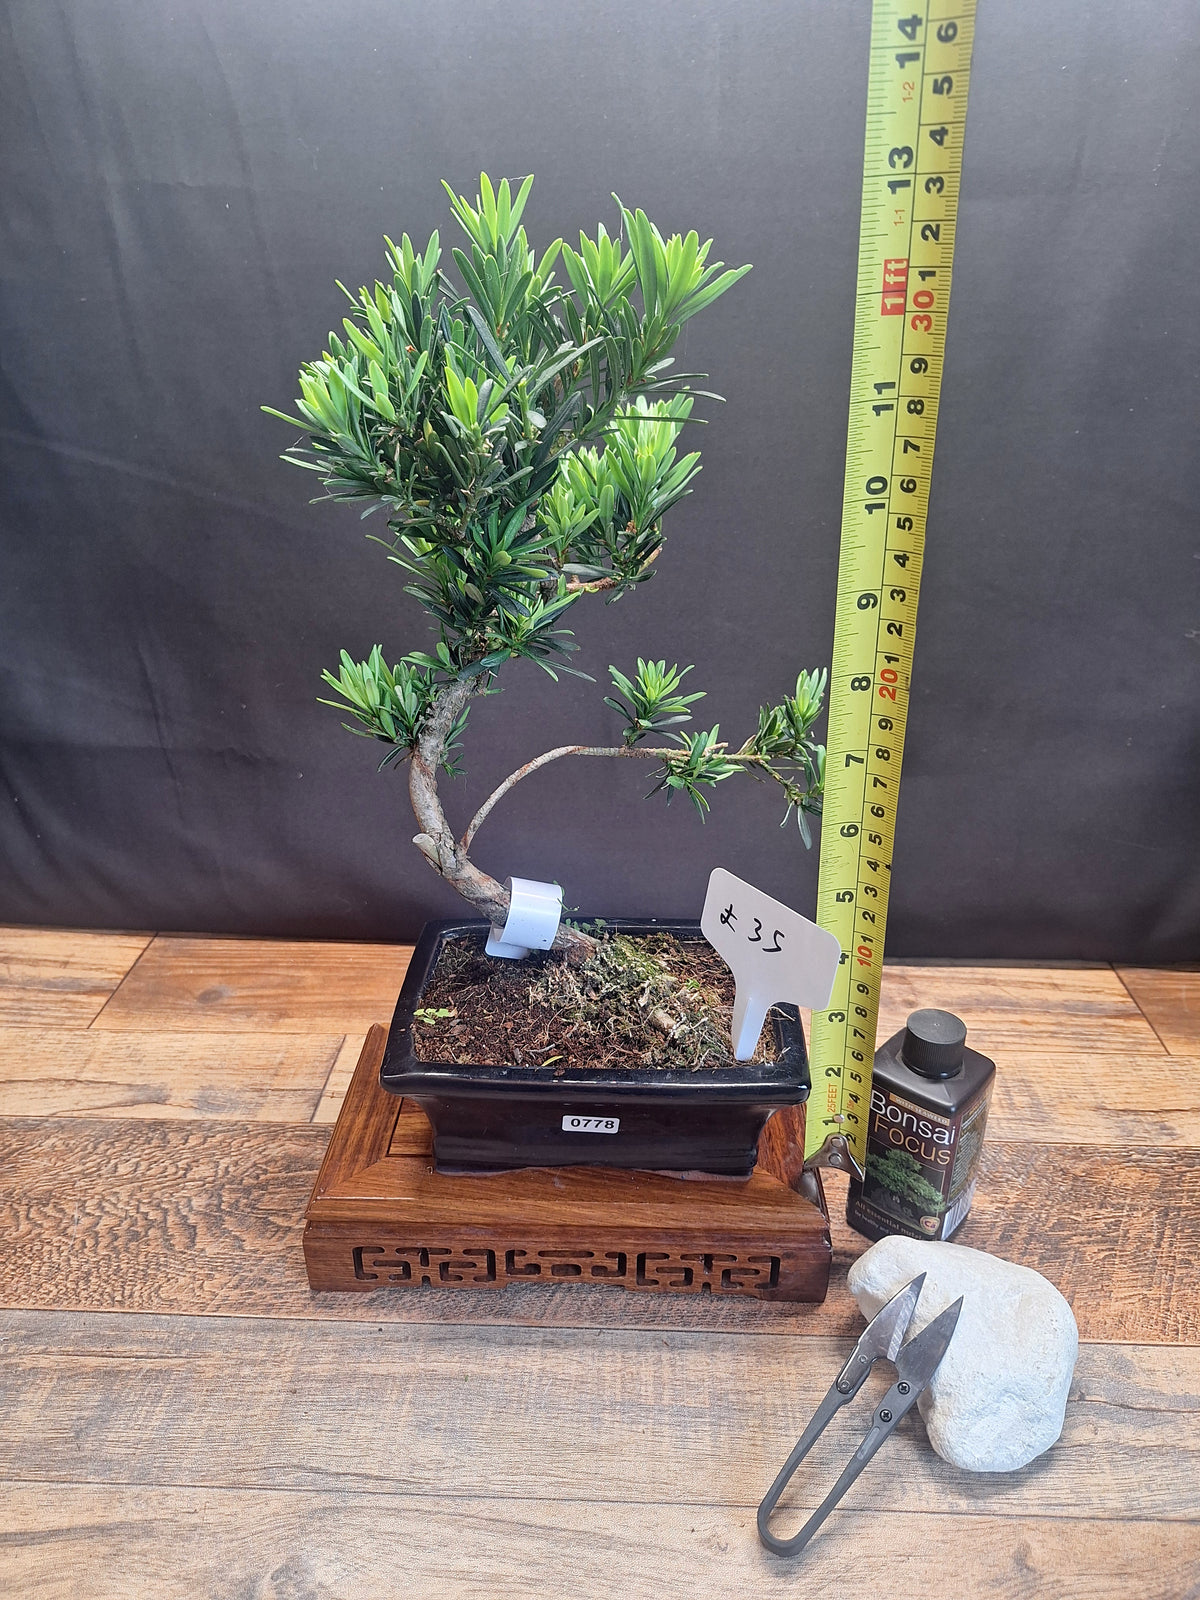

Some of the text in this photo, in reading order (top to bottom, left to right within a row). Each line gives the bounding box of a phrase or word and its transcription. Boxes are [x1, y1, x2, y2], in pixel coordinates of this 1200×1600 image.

[937, 21, 958, 43] 6
[895, 14, 923, 69] 14
[902, 81, 915, 103] 1-2
[932, 75, 953, 95] 5
[929, 126, 948, 146] 4
[887, 146, 914, 195] 13
[925, 176, 944, 194] 3
[893, 209, 905, 226] 1-1
[921, 223, 940, 241] 2
[918, 270, 936, 281] 1
[910, 290, 935, 332] 30
[910, 357, 929, 374] 9
[872, 381, 896, 417] 11
[907, 399, 925, 415] 8
[903, 439, 921, 454] 7
[900, 478, 917, 493] 6
[865, 475, 888, 515] 10
[896, 517, 913, 531] 5
[894, 553, 910, 568] 4
[857, 592, 878, 610] 9
[890, 588, 906, 602] 3
[887, 622, 903, 637] 2
[884, 655, 899, 664] 1
[851, 676, 871, 691] 8
[878, 668, 898, 701] 20
[878, 718, 893, 731] 9
[845, 754, 864, 768] 7
[876, 748, 891, 762] 8
[873, 777, 888, 789] 7
[870, 805, 885, 818] 6
[840, 823, 859, 838] 6
[868, 833, 882, 846] 5
[866, 860, 880, 872] 4
[836, 890, 854, 903] 5
[864, 885, 878, 898] 3
[862, 911, 875, 924] 2
[861, 935, 873, 943] 1
[857, 945, 872, 967] 10
[857, 984, 869, 995] 9
[828, 1012, 845, 1022] 3
[855, 1006, 867, 1018] 8
[853, 1028, 865, 1039] 7
[851, 1051, 864, 1062] 6
[825, 1067, 841, 1077] 2
[850, 1072, 862, 1083] 5
[849, 1093, 860, 1104] 4
[570, 1118, 615, 1129] 0778
[847, 1113, 859, 1124] 3
[870, 1089, 956, 1146] Bonsai
[874, 1115, 951, 1166] Focus
